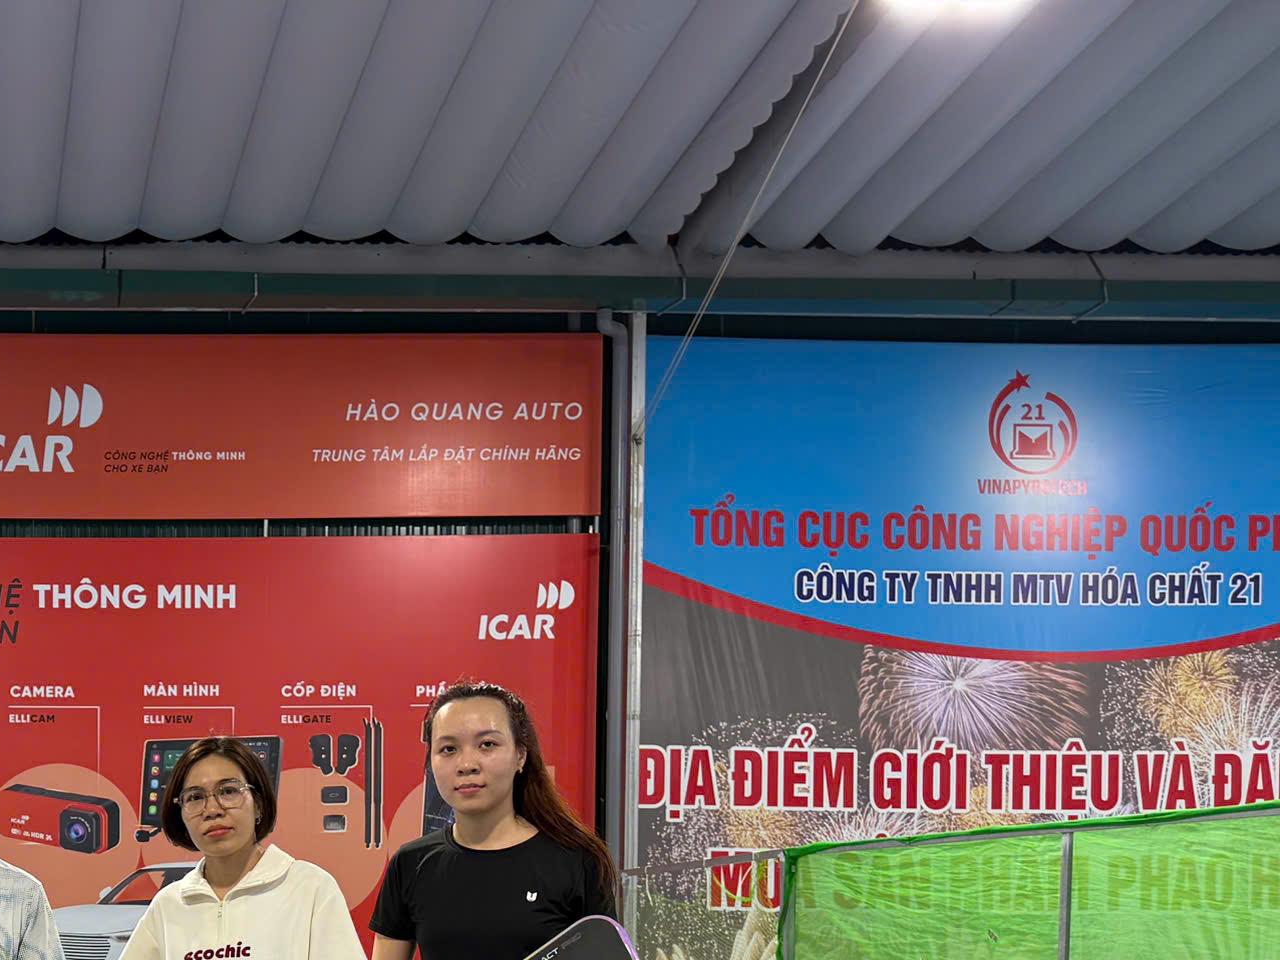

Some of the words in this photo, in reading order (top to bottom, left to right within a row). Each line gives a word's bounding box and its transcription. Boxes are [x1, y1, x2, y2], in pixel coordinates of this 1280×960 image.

[345, 399, 400, 421] HÀO
[410, 401, 505, 422] QUANG
[512, 401, 583, 421] AUTO
[1021, 403, 1046, 420] 21
[171, 450, 212, 461] THÔNG
[216, 451, 246, 461] MINH
[312, 449, 367, 463] TRUNG
[372, 446, 405, 462] TÂM
[409, 443, 439, 462] LẮP
[443, 446, 476, 464] ĐẶT
[479, 445, 530, 461] CHÍNH
[534, 445, 582, 461] HÃNG
[104, 464, 128, 473] CHO
[131, 464, 144, 473] XE
[690, 493, 786, 548] TỔNG
[798, 510, 870, 557] CỤC
[882, 504, 982, 551] CÔNG
[994, 505, 1127, 560] NGHIỆP
[1140, 501, 1235, 556] QUỐC
[33, 577, 147, 609] THÔNG
[157, 584, 237, 609] MINH
[795, 562, 876, 604] CÔNG
[884, 571, 919, 605] TY
[927, 571, 1004, 605] TNHH
[1010, 572, 1074, 605] MTV
[1080, 564, 1141, 605] HÓA
[1147, 561, 1224, 606] CHẤT
[1228, 572, 1262, 605] 21
[478, 614, 556, 640] ICAR
[10, 685, 75, 698] CAMERA
[143, 681, 180, 697] MÀN
[182, 681, 220, 697] HÌNH
[281, 681, 315, 697] CỐP
[320, 682, 357, 701] ĐIỆN
[9, 714, 55, 723] ELLICAM
[143, 714, 193, 724] ELLIVIEW
[638, 744, 718, 821] ĐỊA
[730, 723, 858, 808] ĐIỂM
[871, 736, 971, 811] GIỚI
[982, 738, 1121, 821] THIỆU
[1134, 740, 1200, 810] VÀ
[1211, 739, 1280, 808] ĐĂ
